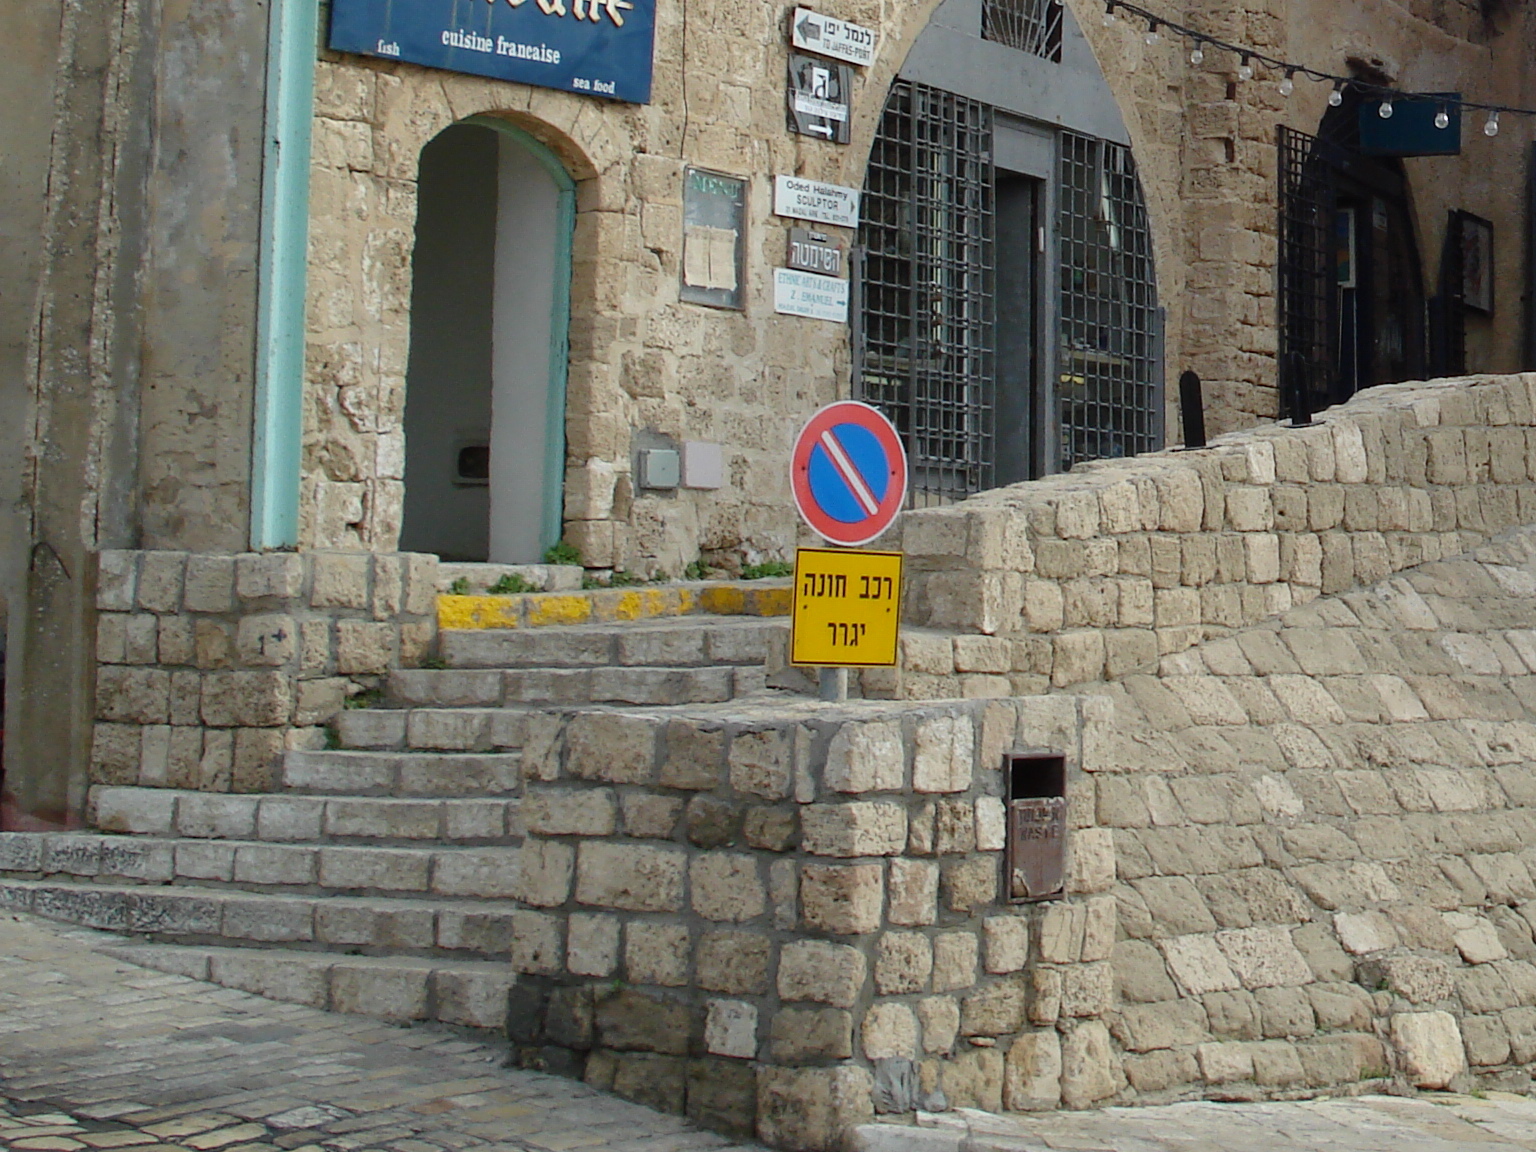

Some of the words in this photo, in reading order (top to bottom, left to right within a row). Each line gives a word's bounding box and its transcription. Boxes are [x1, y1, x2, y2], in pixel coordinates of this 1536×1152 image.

[823, 20, 840, 36] יפו
[843, 23, 872, 46] לנמל
[377, 39, 401, 57] fish
[441, 29, 494, 53] cuisine
[496, 35, 562, 64] francaise
[823, 37, 831, 50] TO
[573, 76, 590, 90] sea
[594, 79, 615, 95] food
[786, 180, 810, 193] Oded
[796, 194, 839, 211] SCULPTOR
[803, 572, 847, 598] חונה
[859, 575, 893, 600] רכב
[827, 622, 866, 647] יגרר
